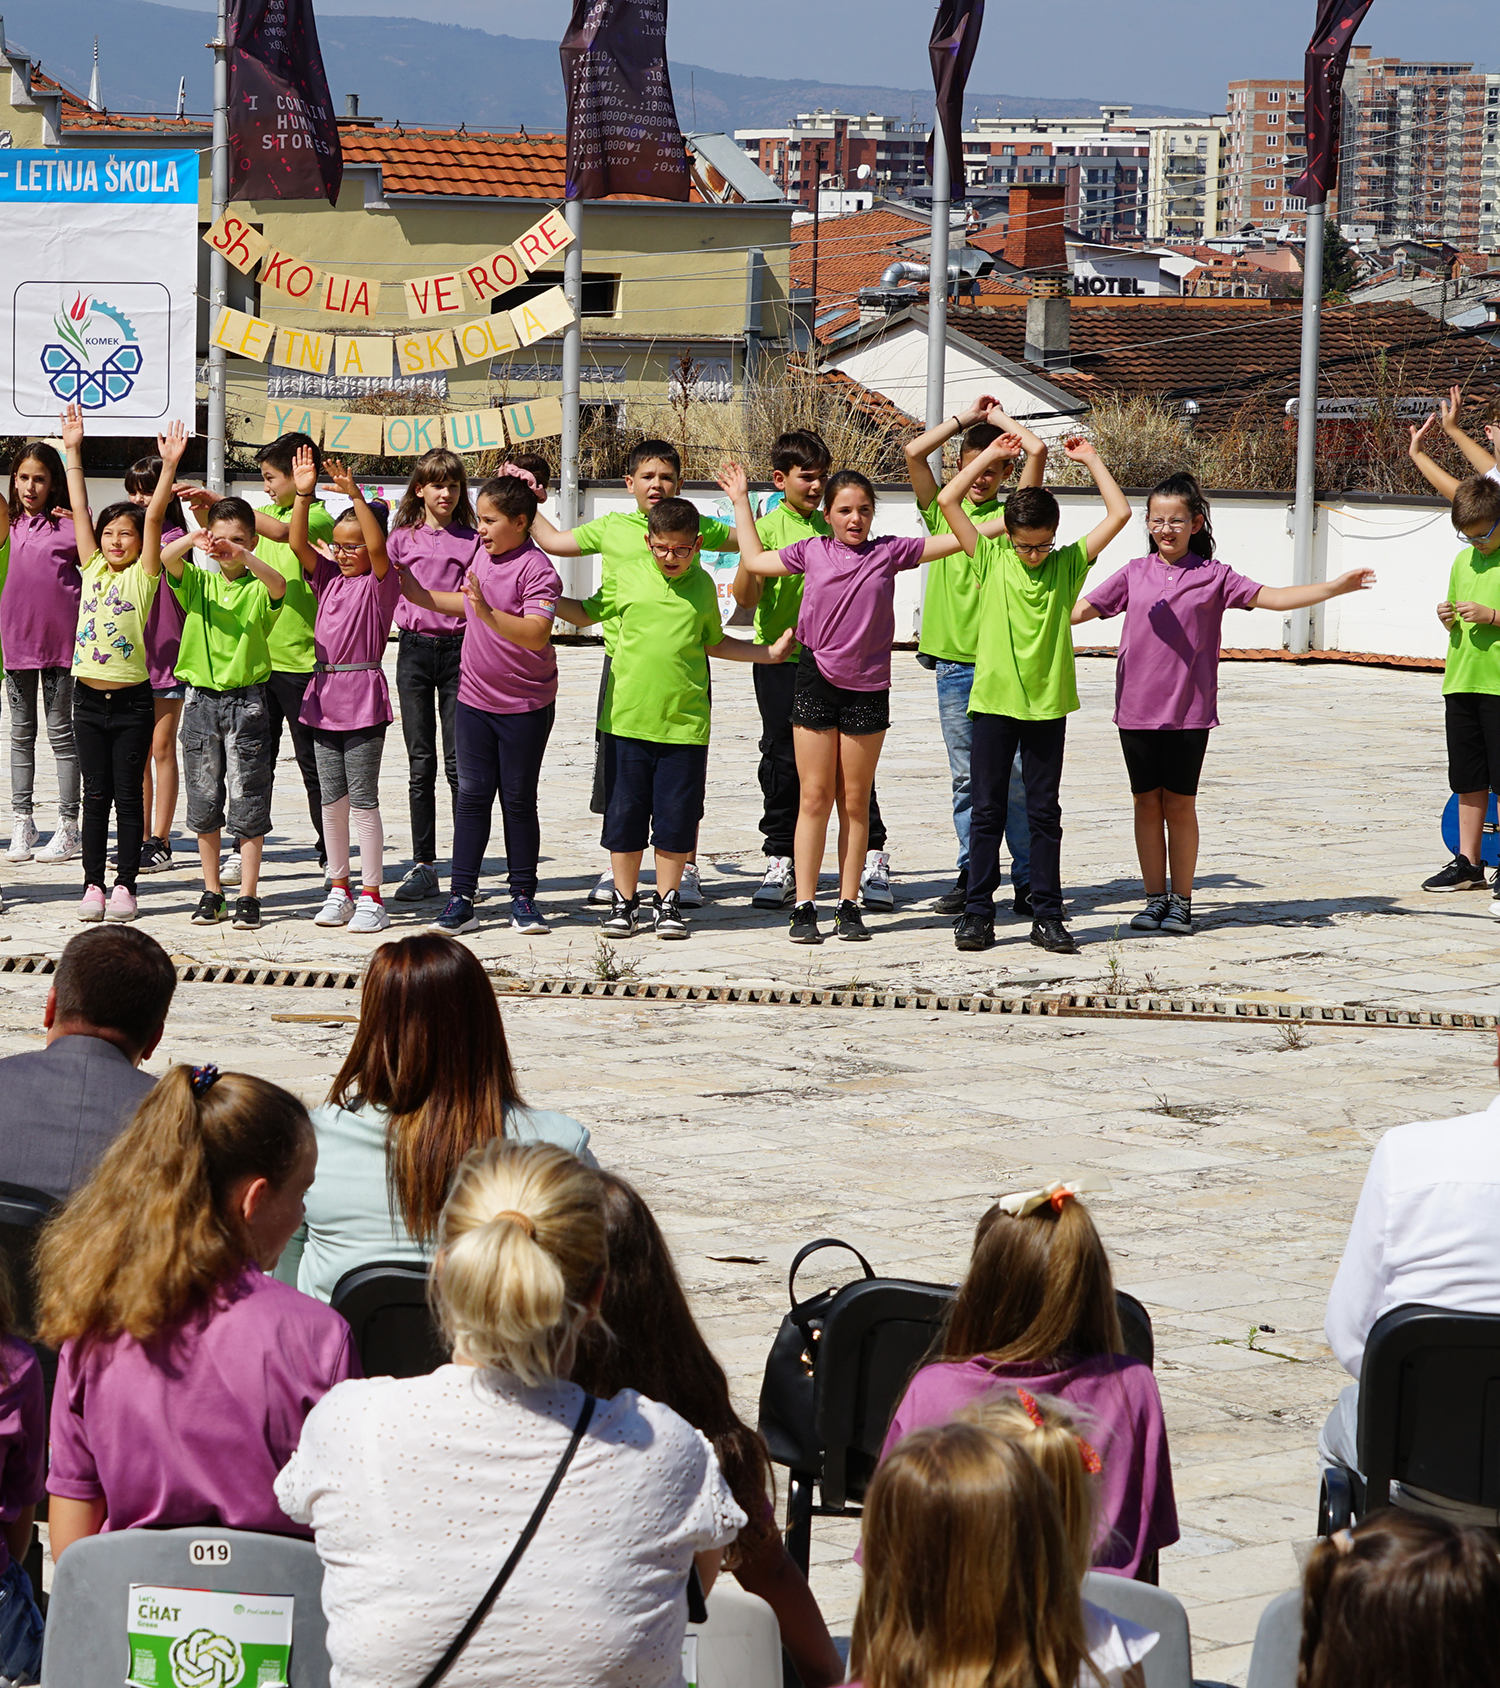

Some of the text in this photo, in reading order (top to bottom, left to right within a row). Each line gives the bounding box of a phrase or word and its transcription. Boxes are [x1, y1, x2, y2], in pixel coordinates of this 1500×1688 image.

[248, 95, 327, 121] I CONTAIN
[277, 114, 317, 135] HUMAN
[15, 160, 98, 191] LETNJA
[104, 154, 180, 192] ŠKOLA
[410, 215, 568, 315] VERORE
[1074, 276, 1145, 294] HOTEL
[85, 337, 119, 346] KOMEK
[403, 305, 547, 372] ŠKOLA
[274, 404, 536, 452] YAZ OKULU
[194, 1544, 228, 1561] 019
[138, 1595, 156, 1603] Let's
[138, 1604, 182, 1622] CHAT
[137, 1620, 159, 1629] Green
